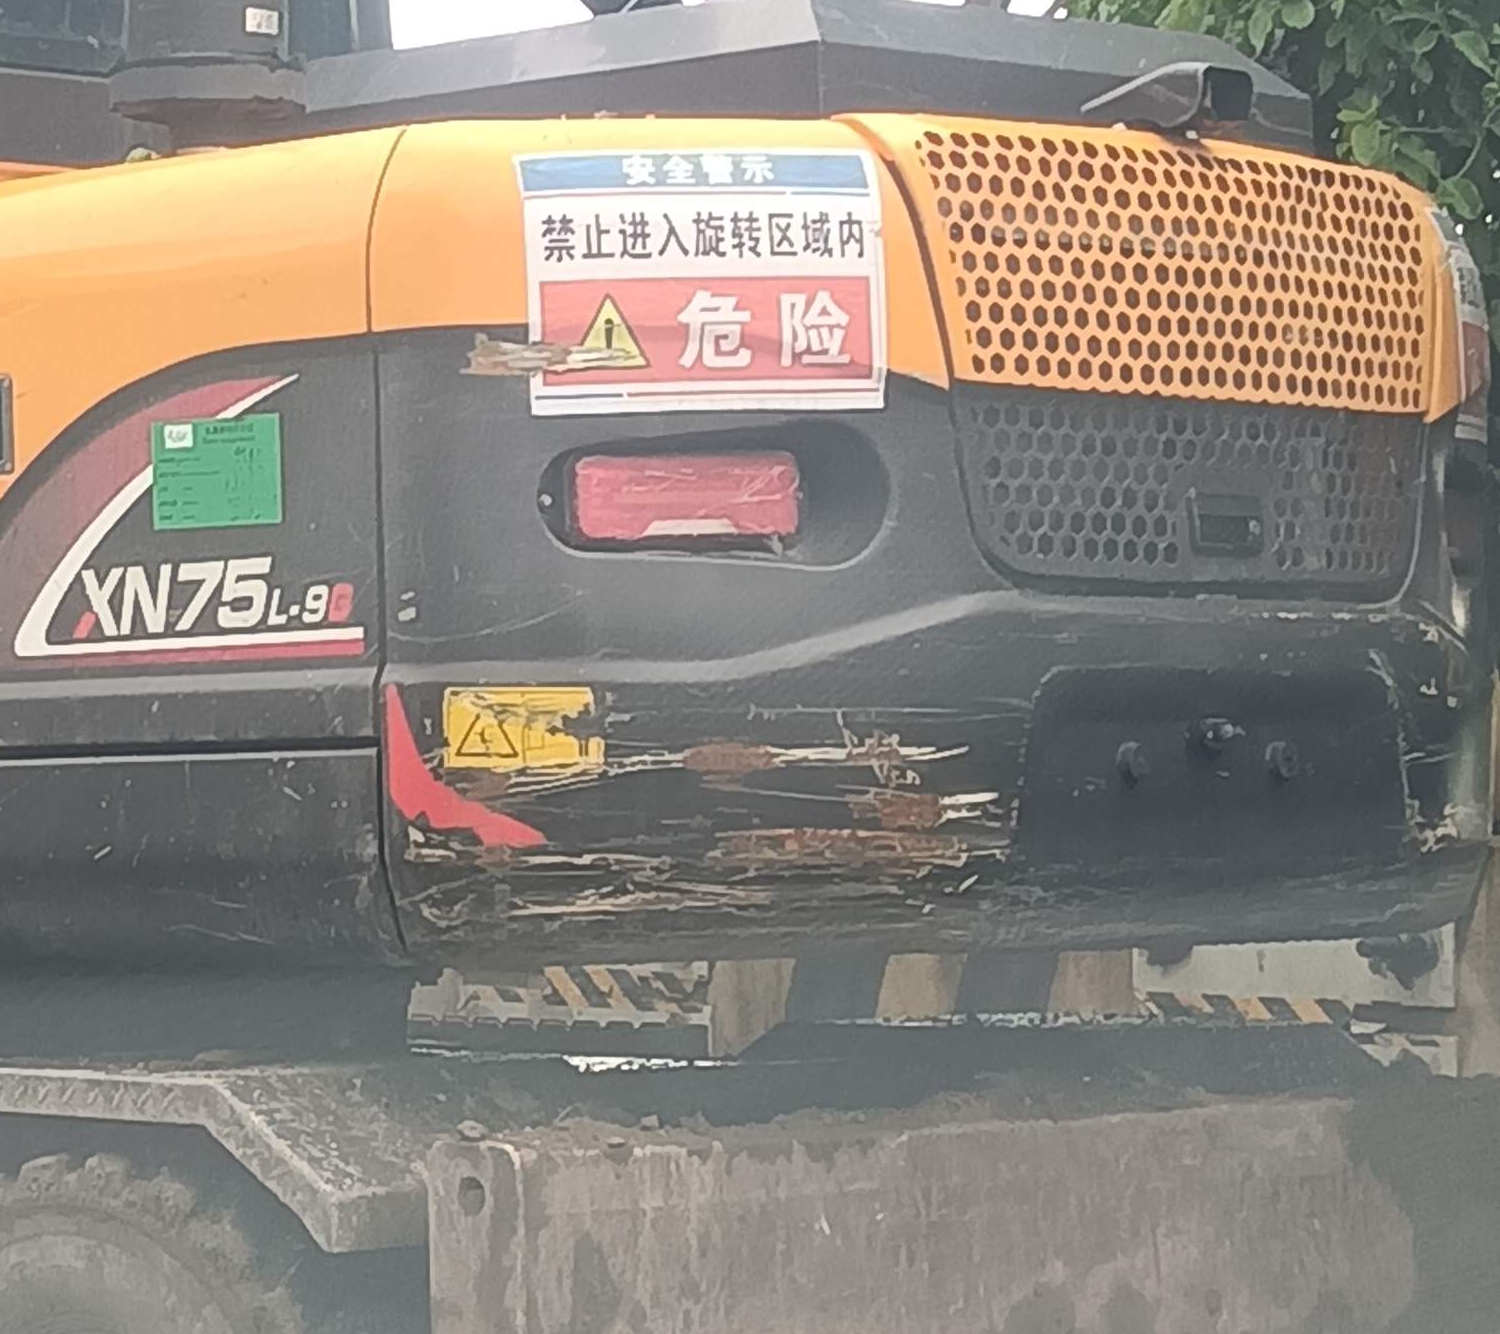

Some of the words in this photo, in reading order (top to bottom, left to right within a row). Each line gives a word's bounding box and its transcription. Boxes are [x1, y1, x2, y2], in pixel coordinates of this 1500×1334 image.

[621, 153, 775, 186] 安全警示
[540, 211, 865, 263] 禁止进入旋转区域内
[676, 289, 853, 370] 危险
